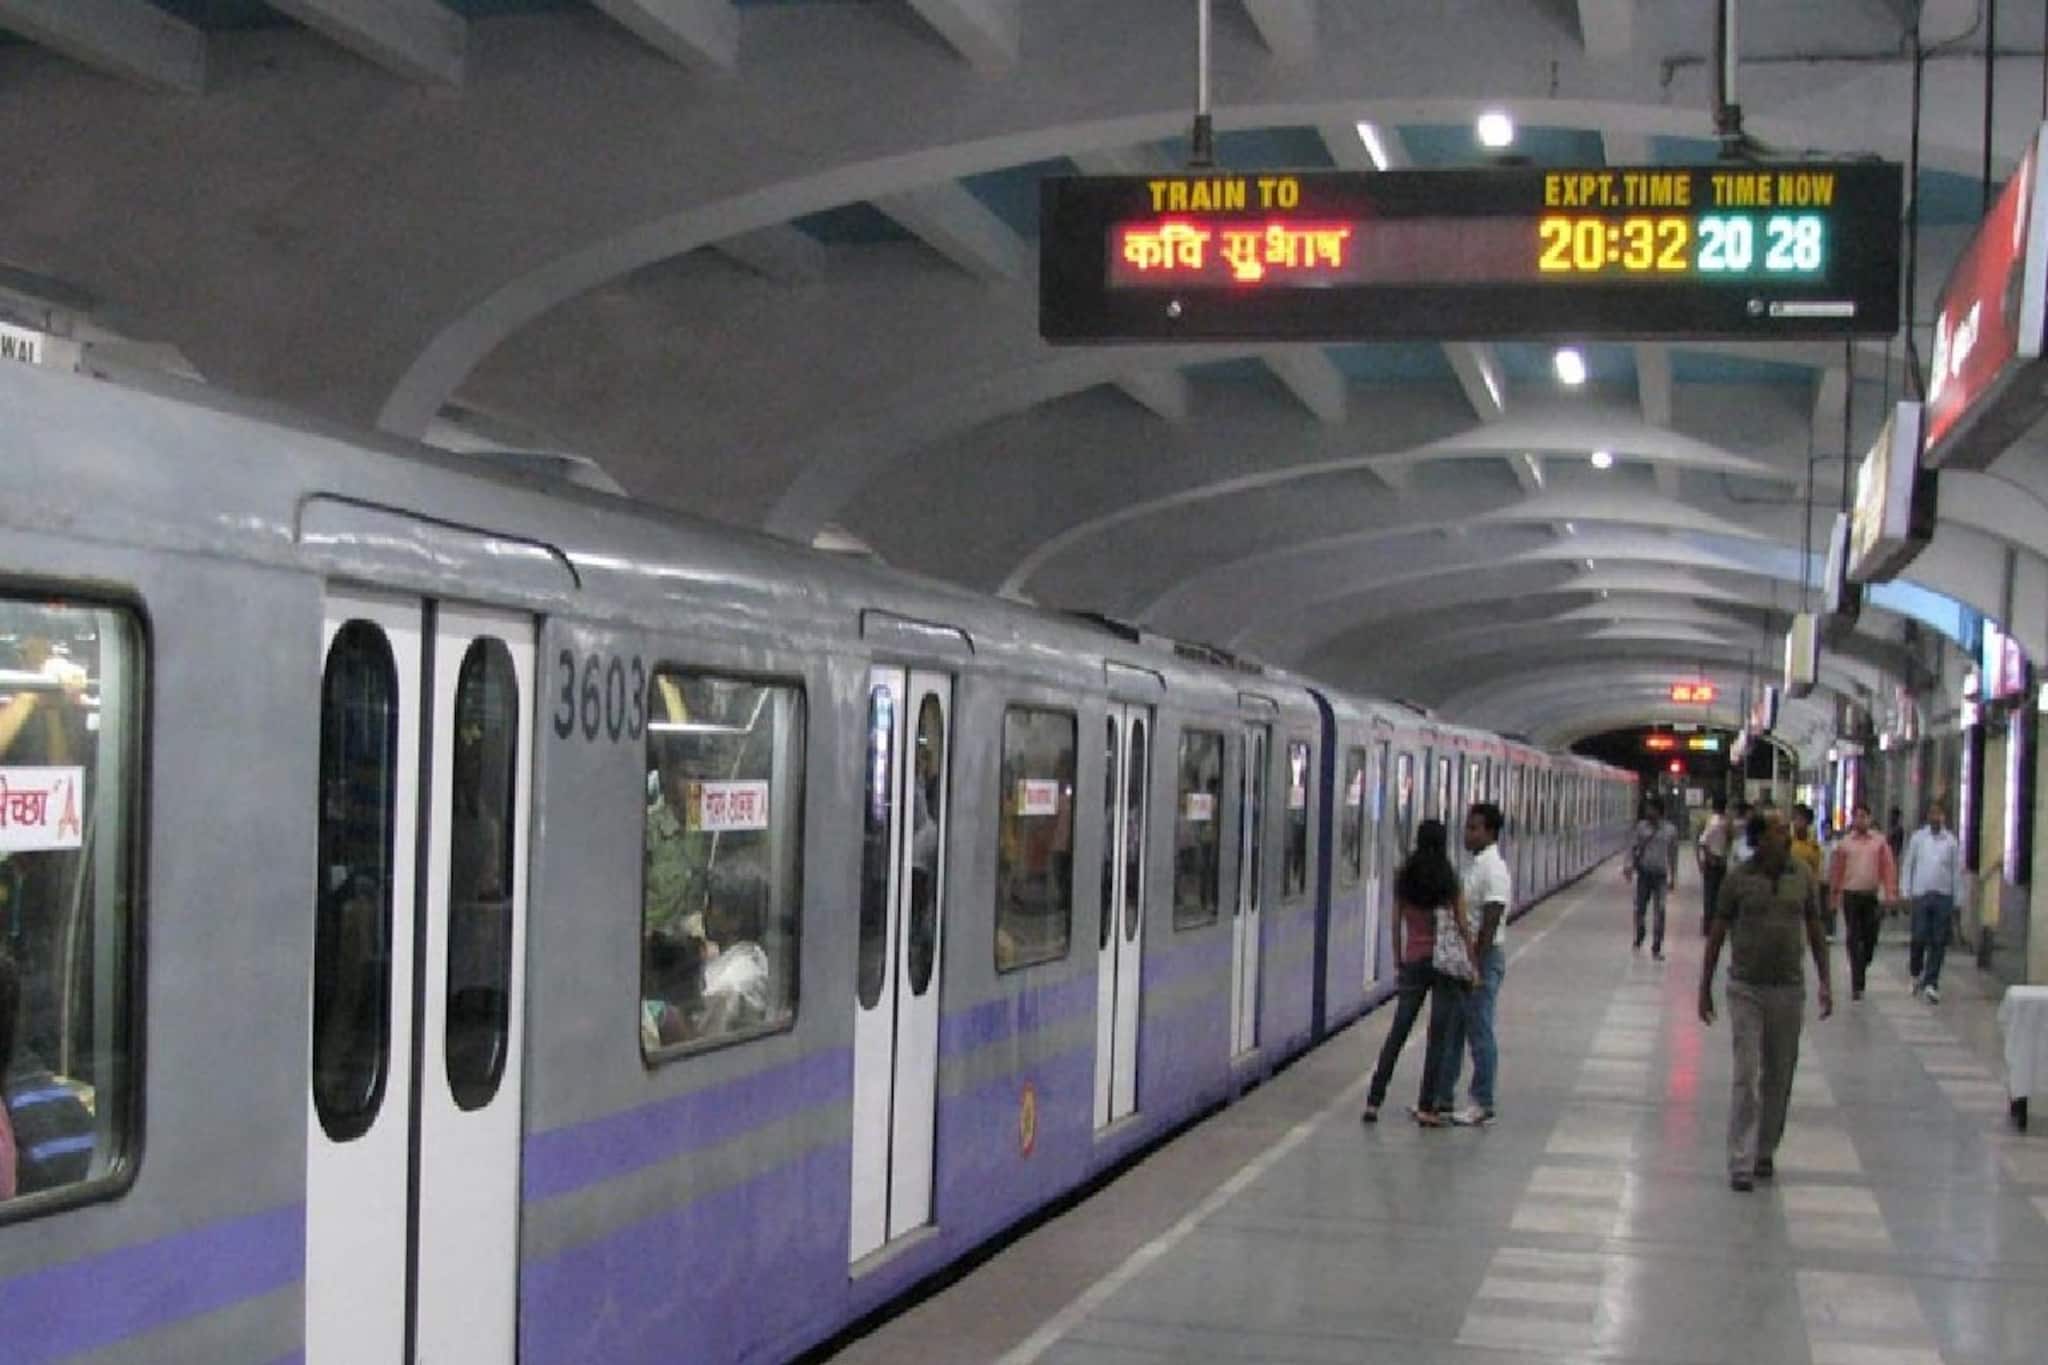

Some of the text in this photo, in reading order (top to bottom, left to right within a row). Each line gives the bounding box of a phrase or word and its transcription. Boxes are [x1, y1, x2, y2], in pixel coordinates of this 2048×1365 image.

[1149, 177, 1300, 211] TRAIN TO
[1711, 175, 1834, 206] TIME NOW
[1123, 221, 1211, 269] कवि
[1538, 217, 1688, 271] 20:32
[1697, 215, 1822, 271] 20 28
[554, 648, 645, 744] 3603
